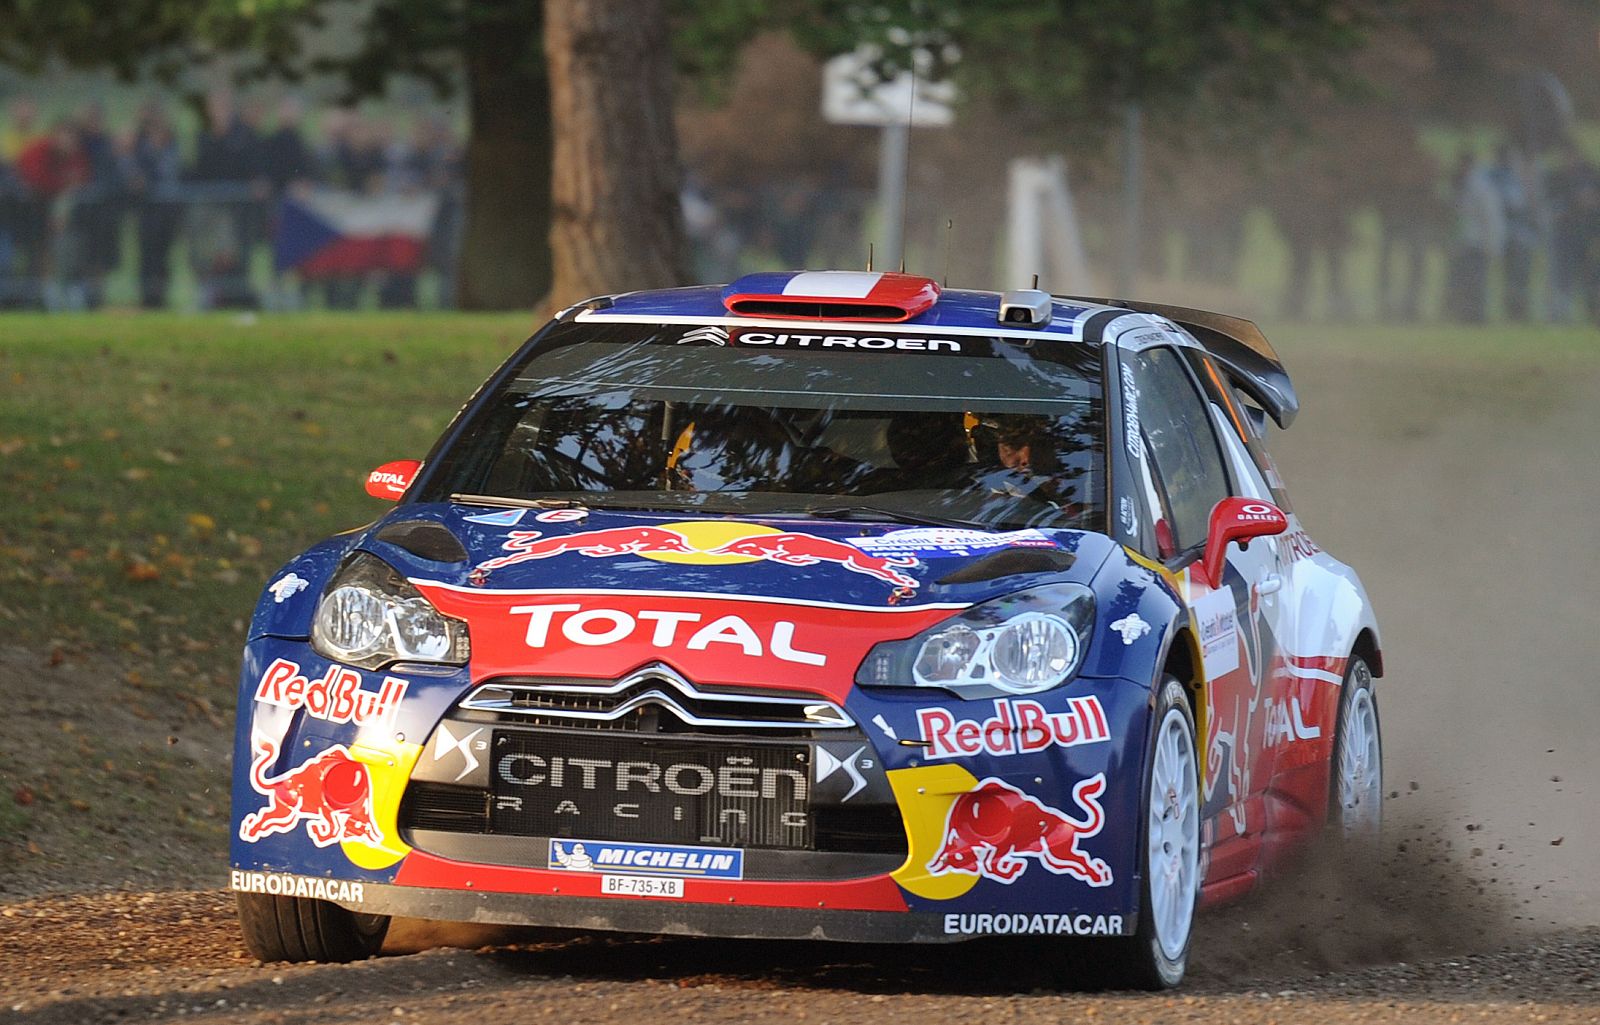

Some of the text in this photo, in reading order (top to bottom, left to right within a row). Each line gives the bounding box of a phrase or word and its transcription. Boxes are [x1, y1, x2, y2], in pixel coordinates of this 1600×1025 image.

[739, 333, 961, 351] CITROEN
[368, 471, 406, 486] TOTAL
[509, 603, 827, 667] TOTAL
[1263, 697, 1320, 749] TOTAL
[596, 848, 734, 870] MICHELIN
[231, 870, 364, 903] EURODATACAR
[608, 878, 677, 896] BF-735-XB
[943, 912, 1123, 936] EURODATACAR
